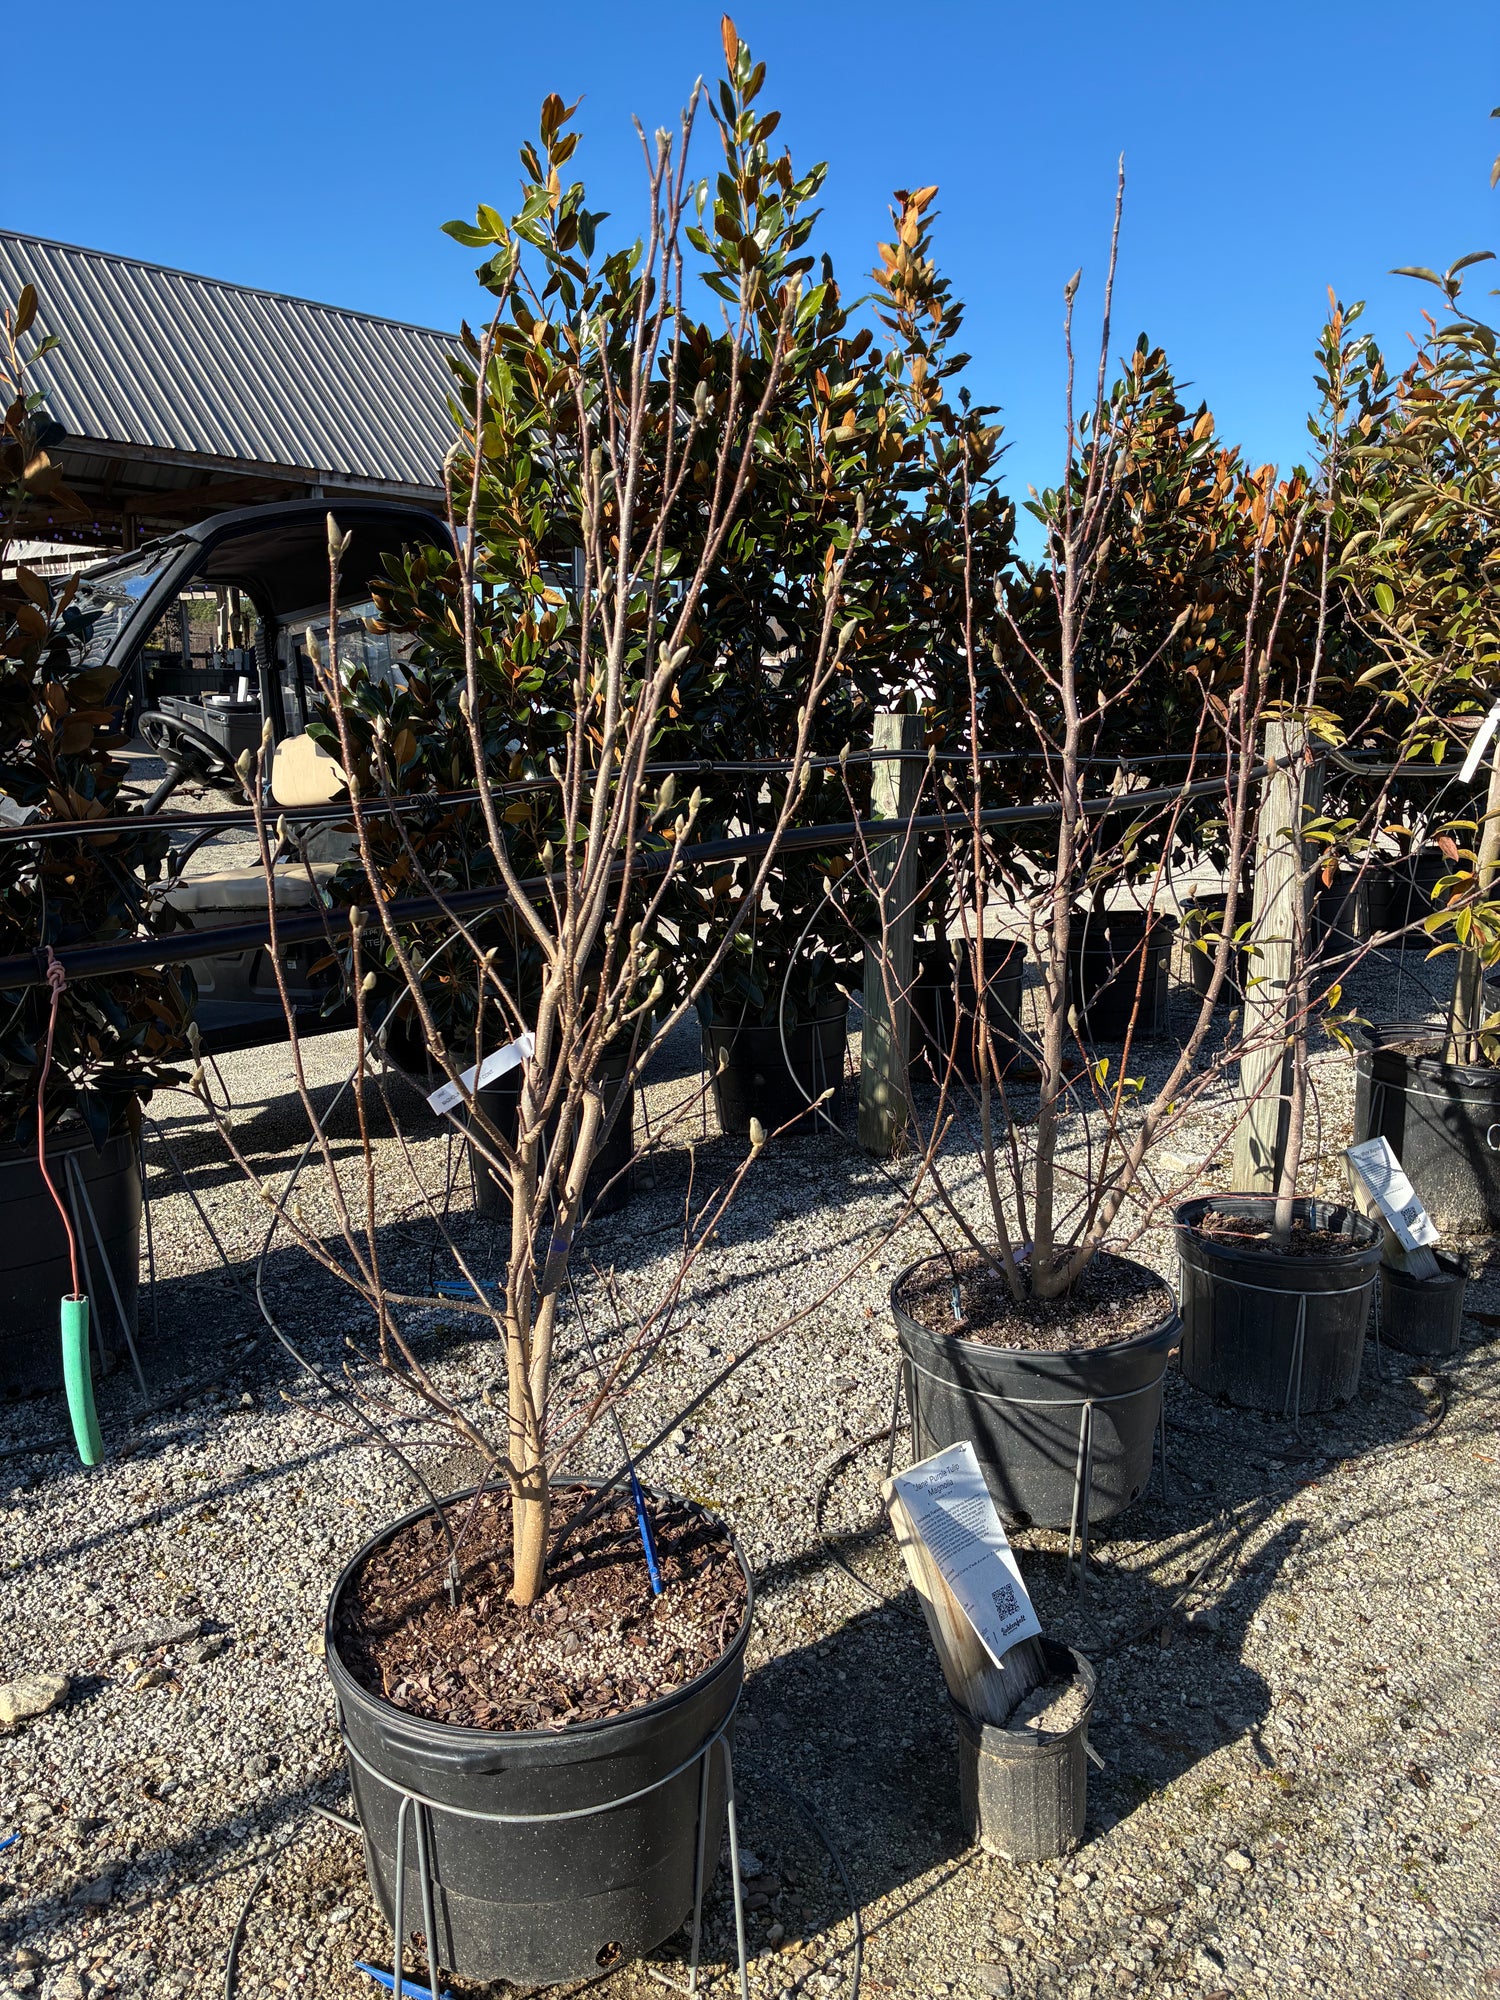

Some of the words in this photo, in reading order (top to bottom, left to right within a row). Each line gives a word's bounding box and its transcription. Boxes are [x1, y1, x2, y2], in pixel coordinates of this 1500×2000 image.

[929, 1470, 948, 1485] Purple
[946, 1463, 960, 1476] Tulip
[928, 1479, 954, 1497] Magnolia
